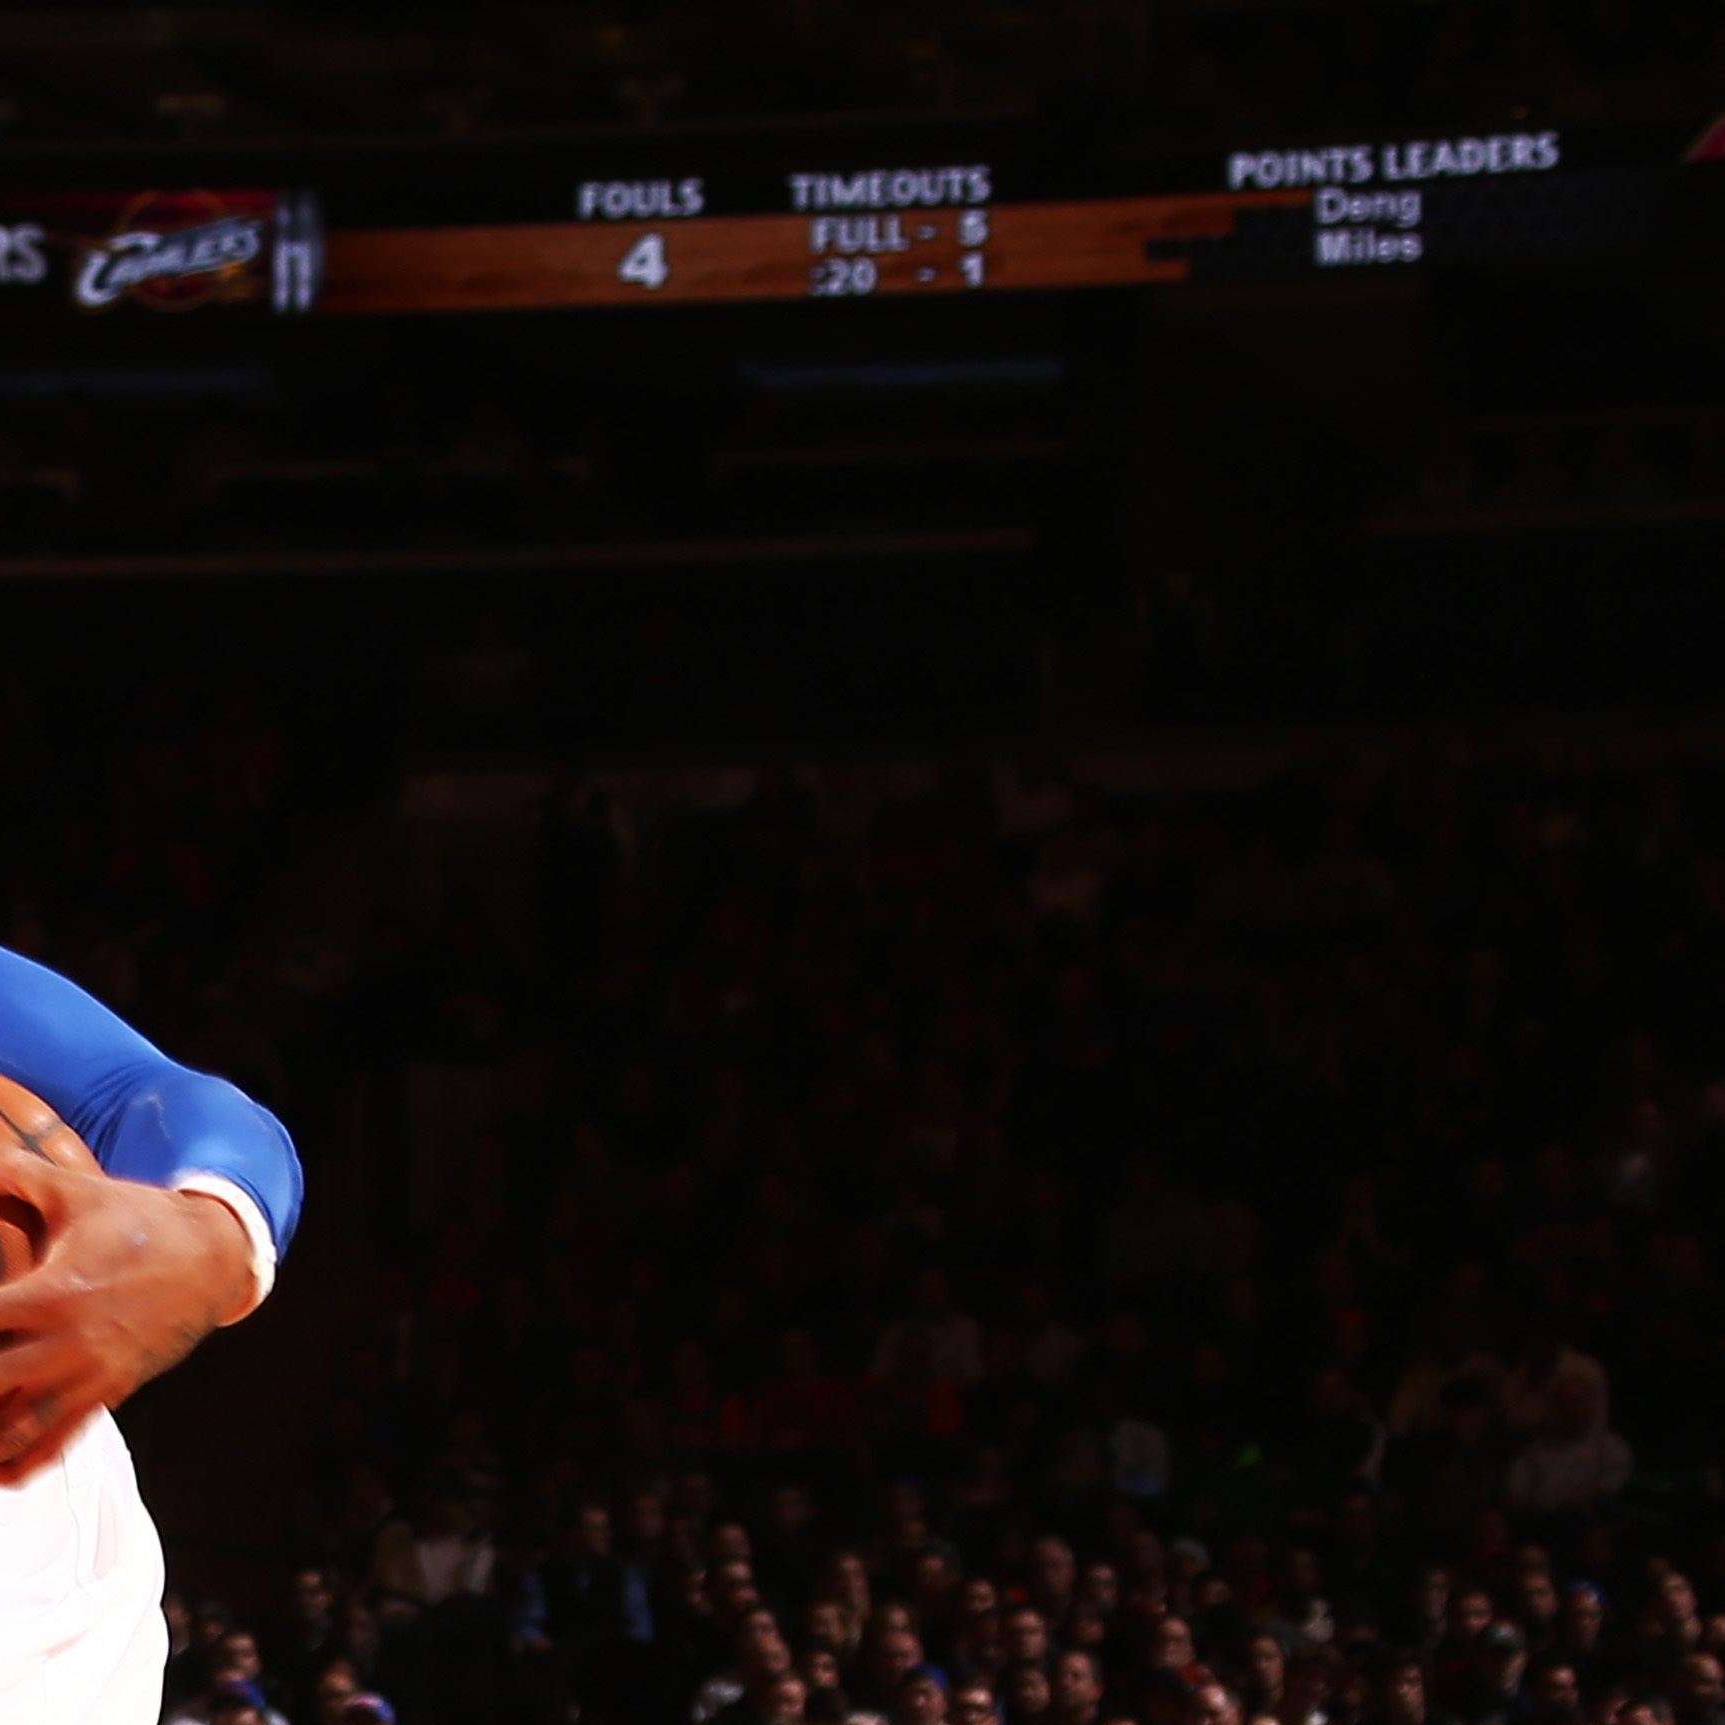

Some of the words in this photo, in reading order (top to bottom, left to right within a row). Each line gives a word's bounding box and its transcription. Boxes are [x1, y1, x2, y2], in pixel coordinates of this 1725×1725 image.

[1228, 143, 1375, 189] POINTS
[1381, 130, 1561, 182] LEADERS
[576, 178, 705, 219] FOULS
[789, 164, 992, 209] TIMEOUTS
[1312, 186, 1423, 229] Deng
[809, 213, 911, 255] FULL
[1312, 228, 1425, 267] Miles
[616, 231, 671, 291] 4
[958, 251, 986, 289] 1
